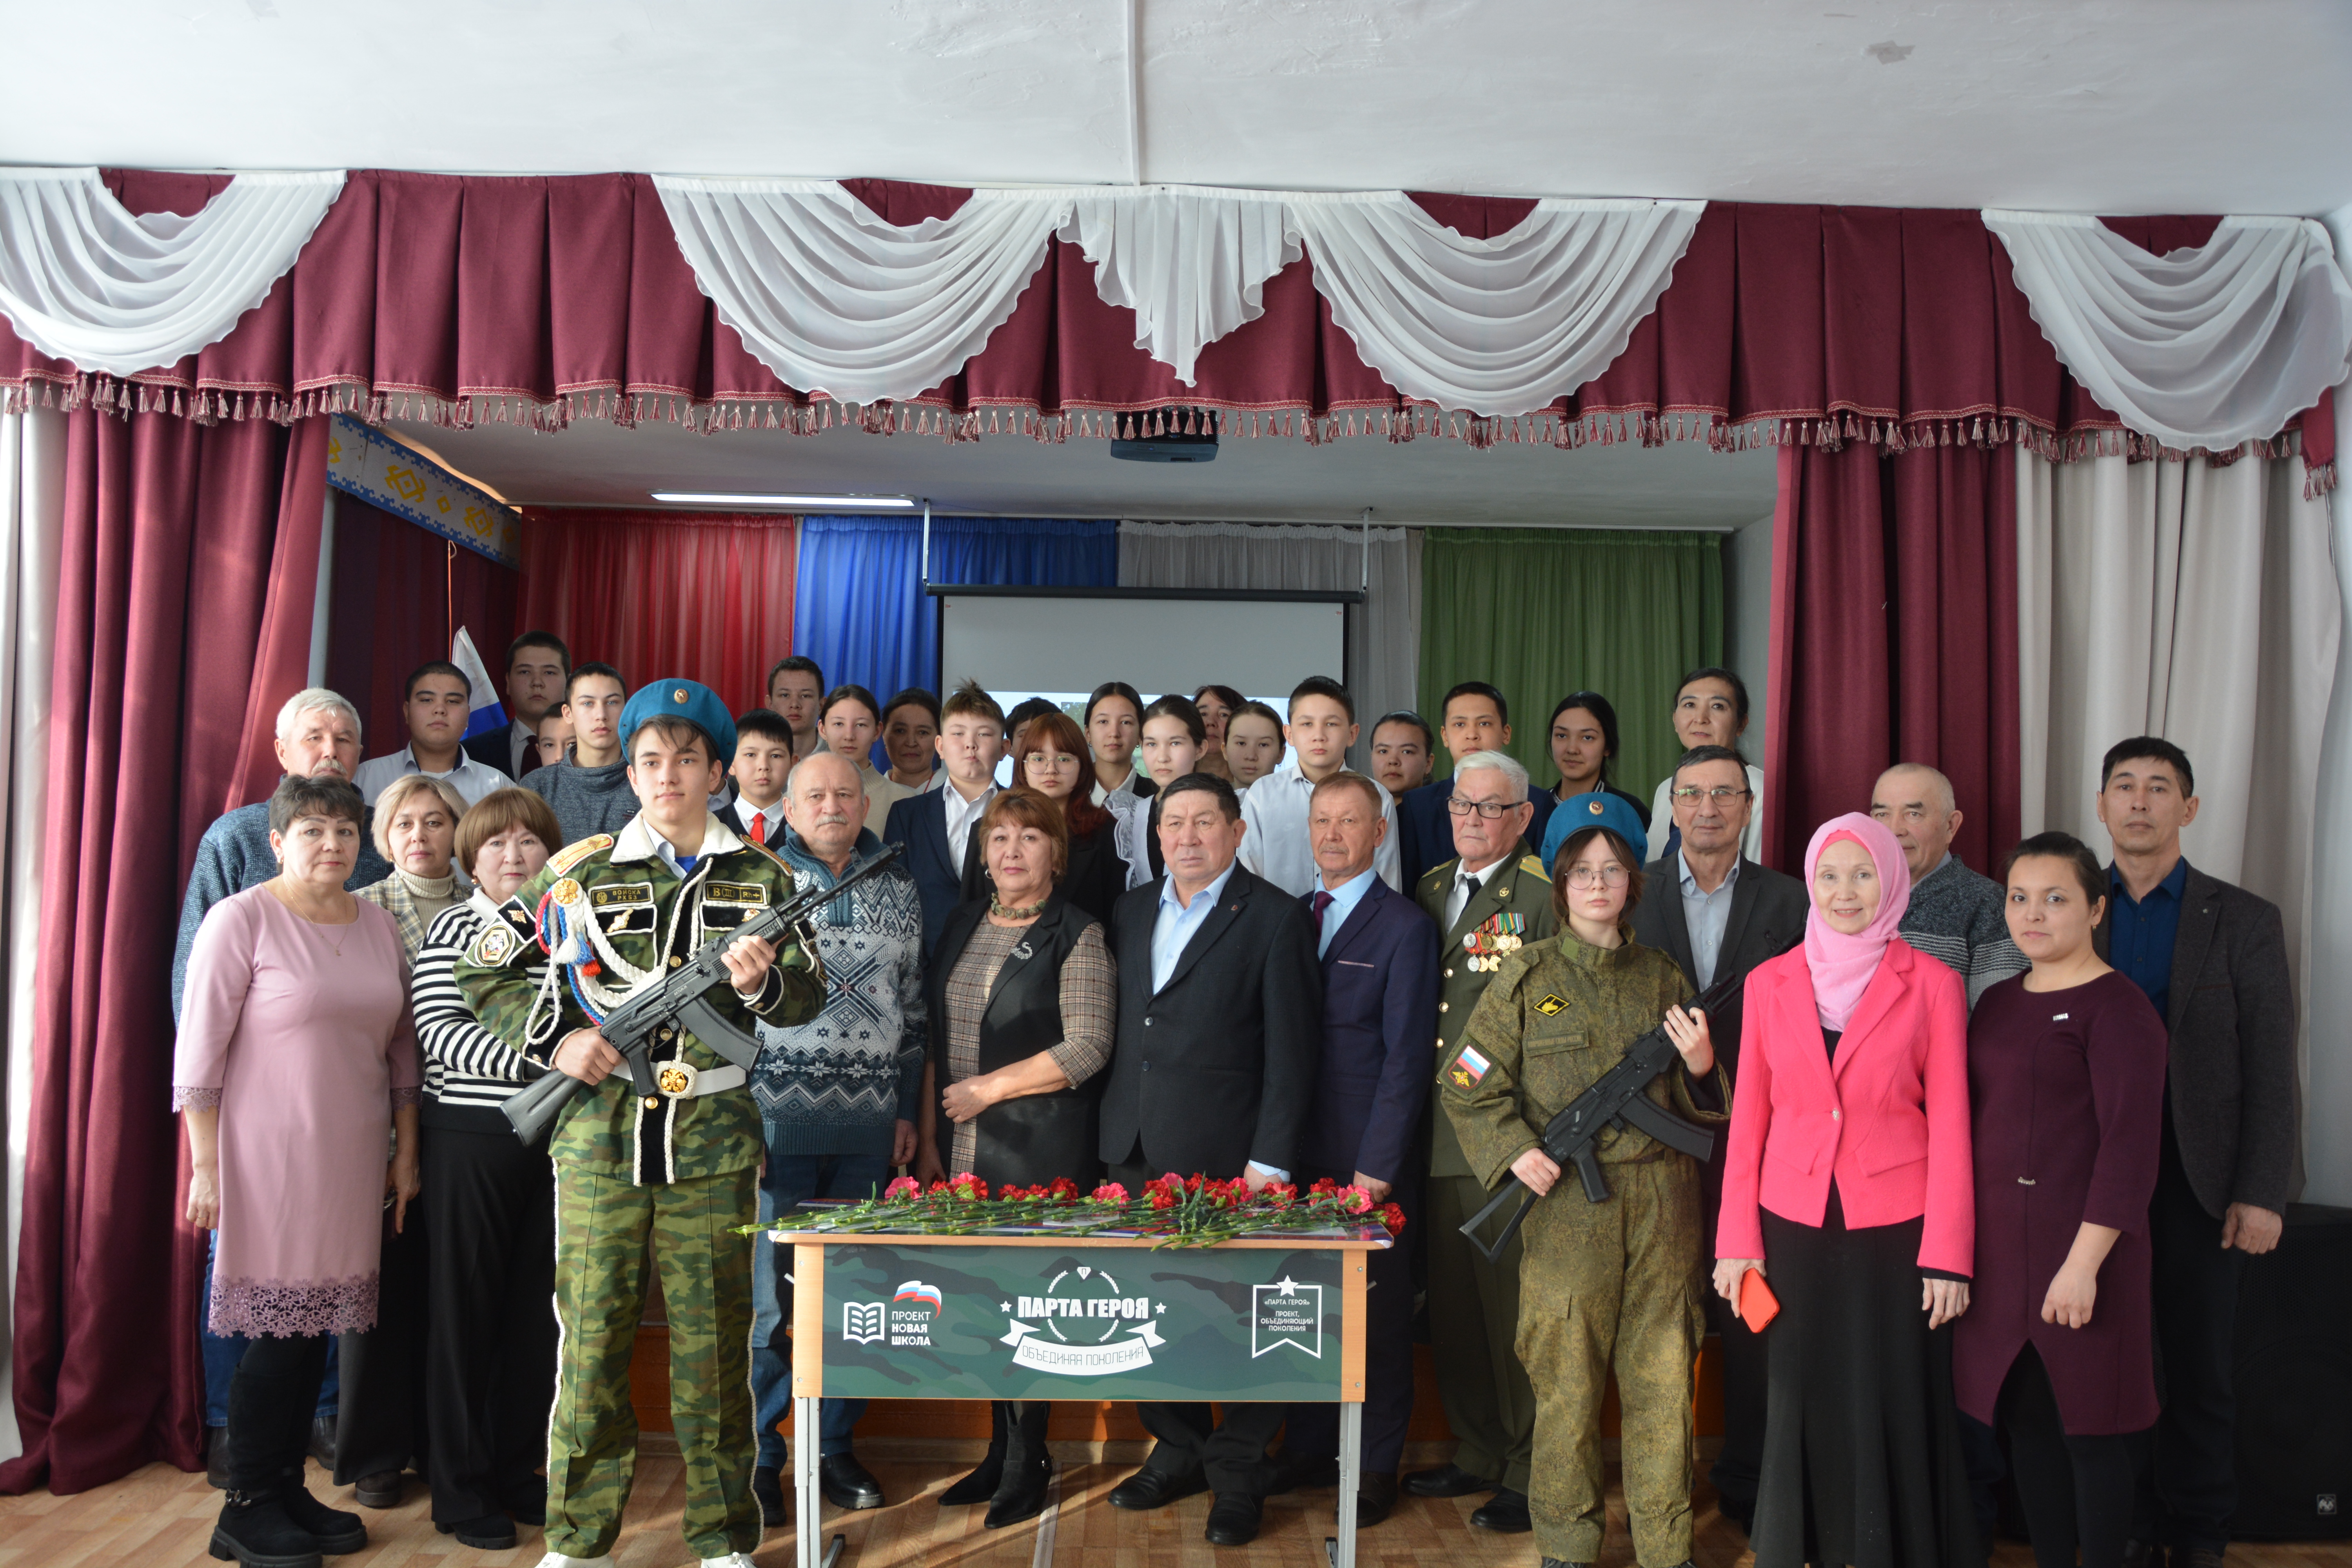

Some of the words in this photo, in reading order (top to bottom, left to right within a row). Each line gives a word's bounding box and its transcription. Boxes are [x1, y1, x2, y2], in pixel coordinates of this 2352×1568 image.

[1018, 1296, 1083, 1318] ПАРТА
[1087, 1297, 1149, 1319] ГЕРОЯ
[892, 1311, 931, 1321] ПРОЕКТ
[1260, 1317, 1314, 1325] ОБЪЕДИНЯЮЩИЙ
[892, 1323, 927, 1333] НОВАЯ
[891, 1336, 931, 1346] ШКОЛА
[1022, 1345, 1082, 1366] ОБЪЕДИНЯЯ
[1085, 1346, 1143, 1366] ПОКОЛЕНИЯ
